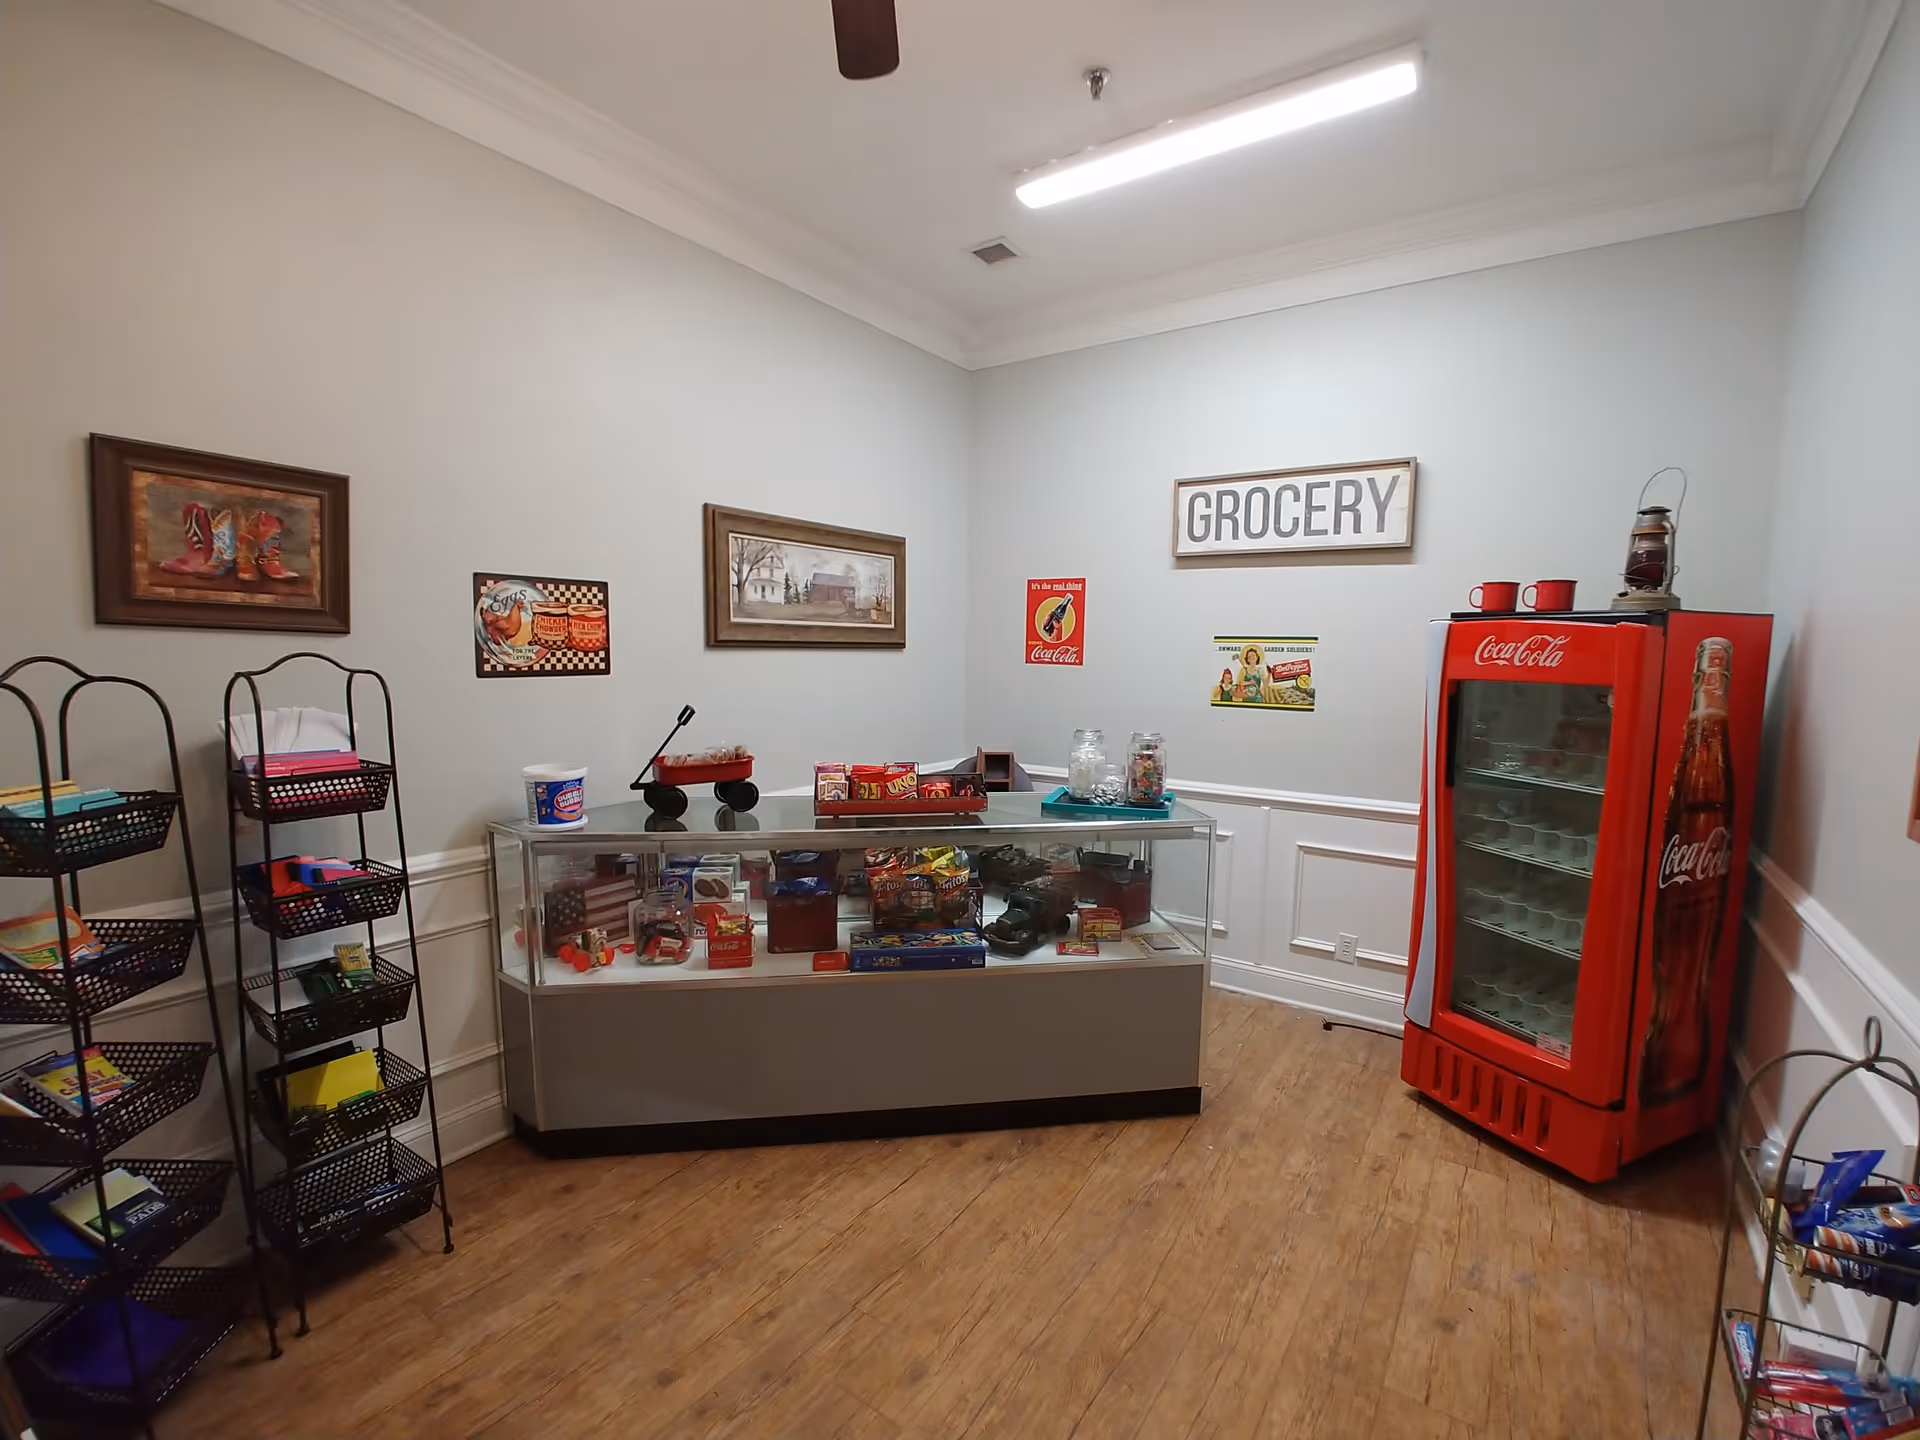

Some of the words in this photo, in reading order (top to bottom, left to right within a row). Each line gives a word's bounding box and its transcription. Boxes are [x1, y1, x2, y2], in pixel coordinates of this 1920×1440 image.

[1187, 475, 1400, 543] GROCERY
[1041, 582, 1051, 590] the
[1053, 582, 1065, 590] real
[1066, 581, 1082, 591] thing
[490, 589, 527, 613] Eggs
[1474, 634, 1571, 667] Coca-Cola
[886, 772, 917, 795] UNO
[942, 874, 966, 889] Fritos
[126, 1202, 166, 1224] PADS
